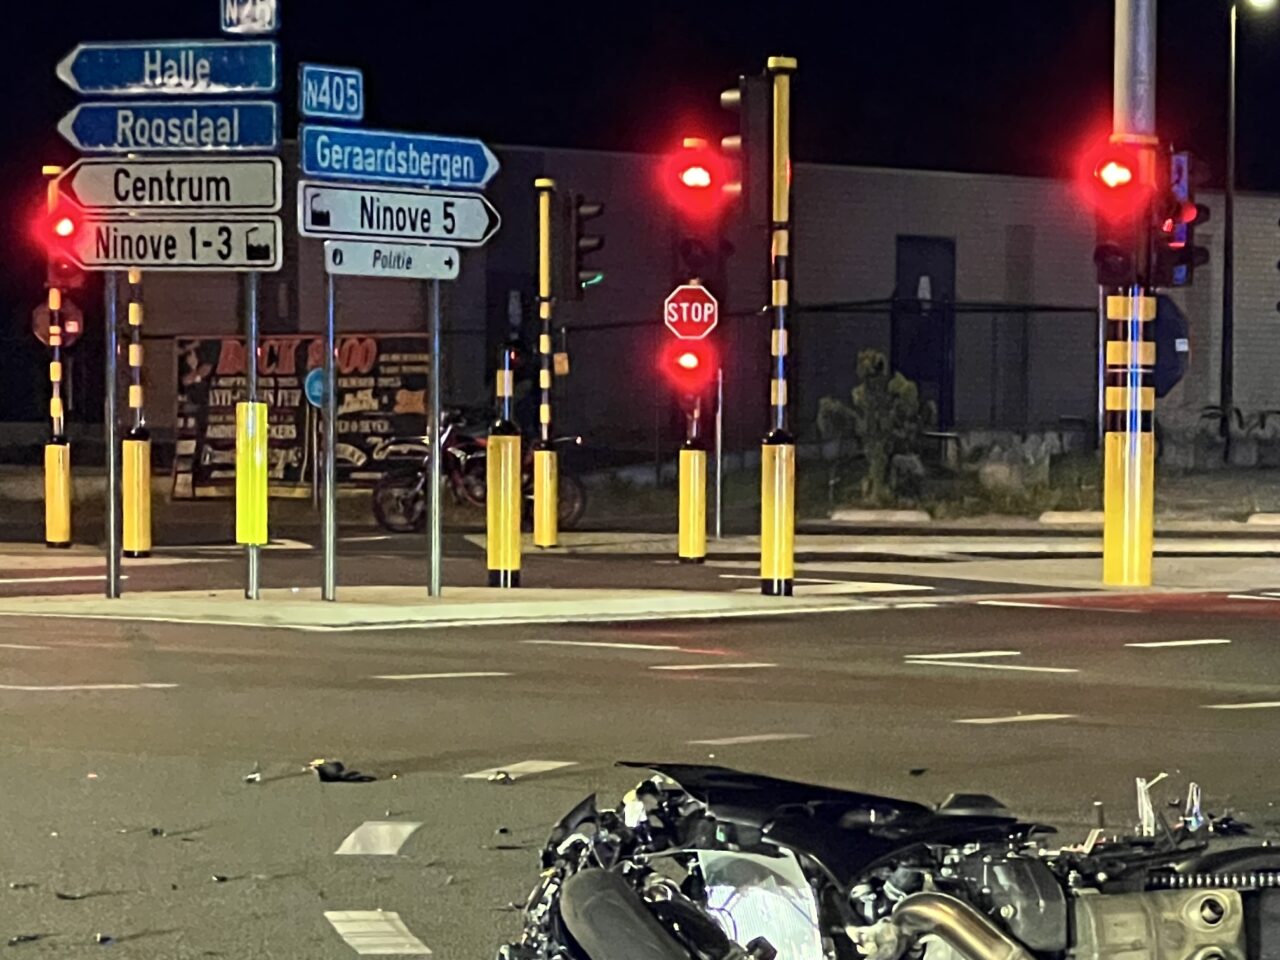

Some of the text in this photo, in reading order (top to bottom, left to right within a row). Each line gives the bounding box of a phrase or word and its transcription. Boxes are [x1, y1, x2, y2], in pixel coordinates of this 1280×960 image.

[144, 49, 211, 87] Halle
[306, 75, 359, 112] N405
[116, 107, 240, 145] Roosdaal
[316, 134, 476, 186] Geraardsbergen
[113, 167, 232, 202] Centrum
[359, 194, 456, 235] Ninove 5
[95, 225, 233, 261] Ninove 1-3
[372, 248, 413, 271] Politie
[668, 302, 715, 323] STOP
